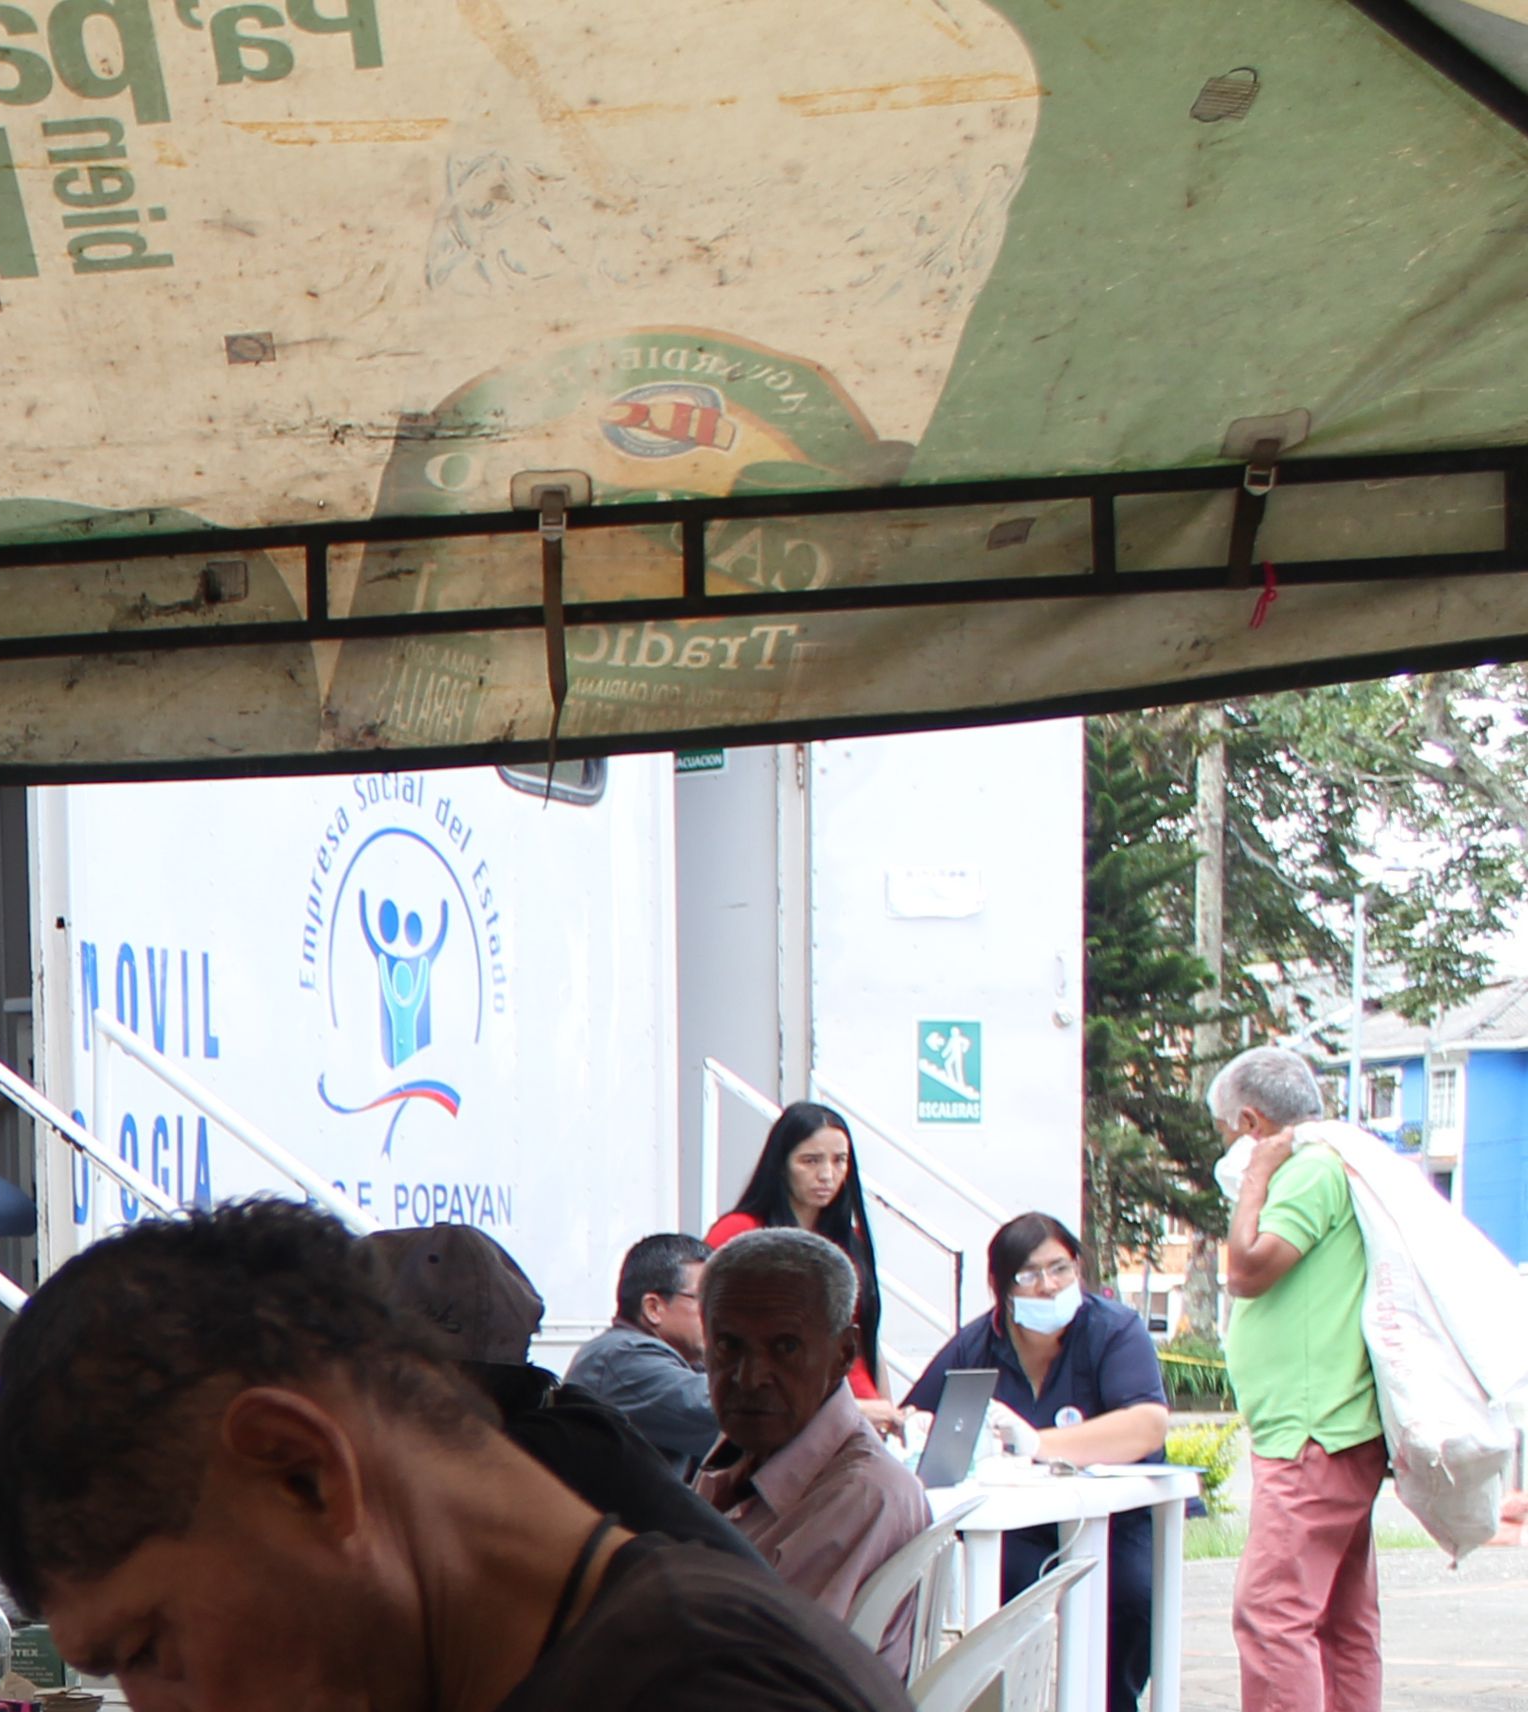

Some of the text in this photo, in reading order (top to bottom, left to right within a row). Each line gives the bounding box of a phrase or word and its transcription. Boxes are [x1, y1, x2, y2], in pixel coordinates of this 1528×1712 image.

[299, 773, 507, 1014] Empresa Social del Estado
[918, 1101, 981, 1120] ESCALERAS
[71, 1109, 213, 1226] OOGIA
[395, 1183, 513, 1226] POPAYAN
